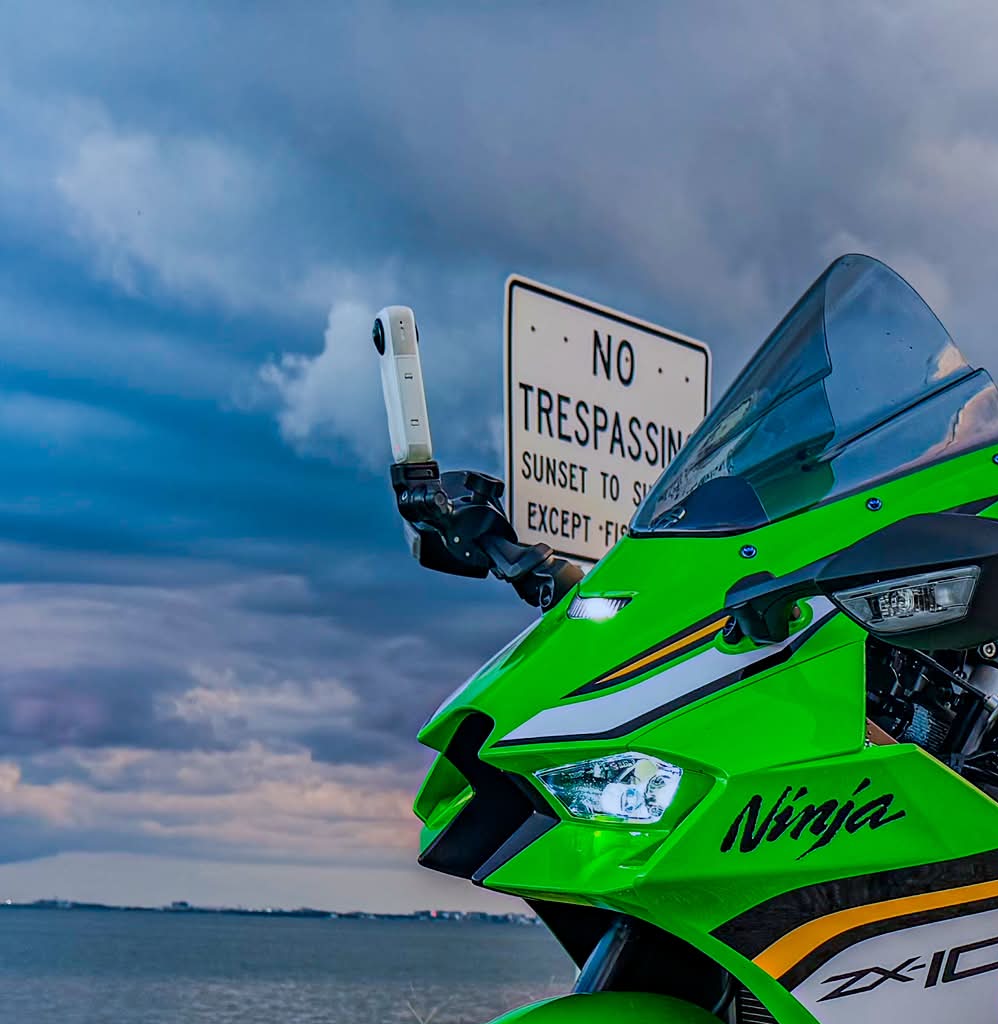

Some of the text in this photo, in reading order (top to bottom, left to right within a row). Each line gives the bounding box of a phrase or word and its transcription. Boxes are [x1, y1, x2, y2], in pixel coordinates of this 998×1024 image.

[592, 329, 635, 387] NO
[518, 382, 691, 469] TRESPASSIN
[521, 451, 588, 494] SUNSET
[600, 471, 620, 501] TO
[527, 501, 592, 543] EXCEPT
[719, 777, 906, 861] Ninja
